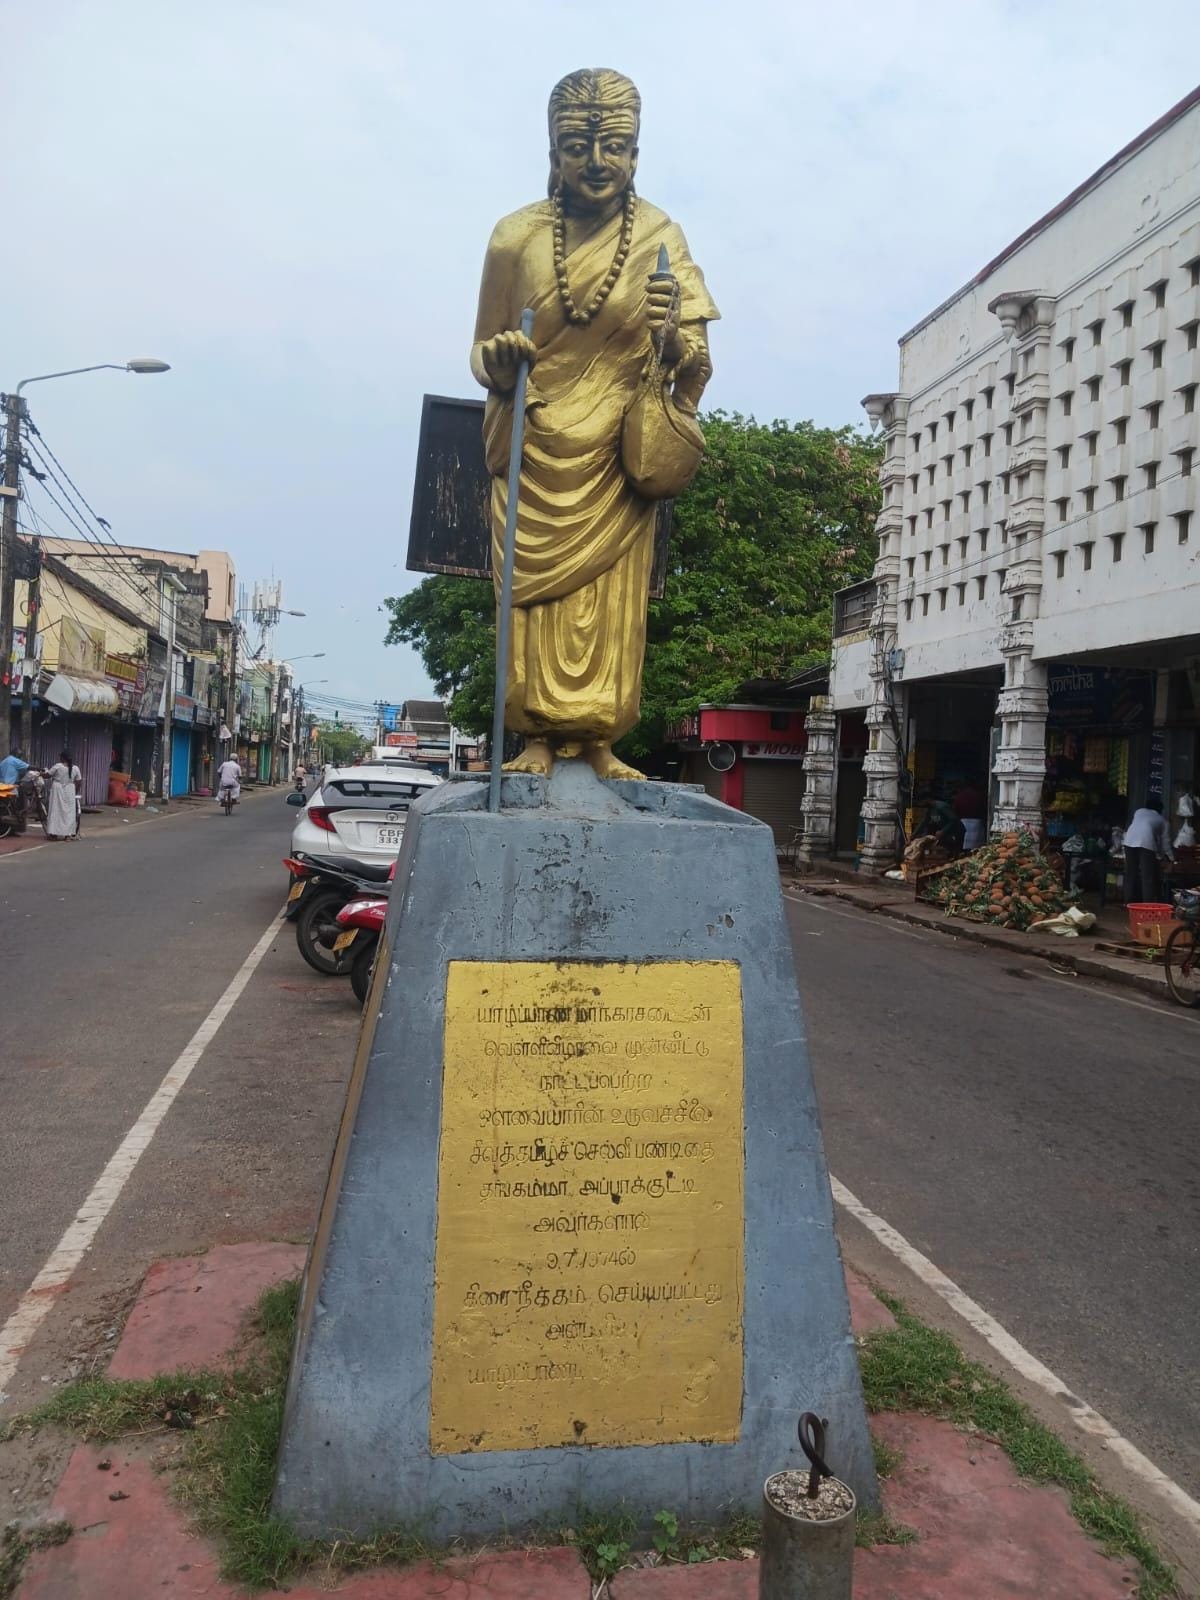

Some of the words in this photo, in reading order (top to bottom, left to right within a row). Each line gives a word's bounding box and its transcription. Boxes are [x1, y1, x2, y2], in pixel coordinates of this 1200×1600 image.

[378, 836, 403, 845] 333
[574, 1136, 632, 1161] செல்வி
[635, 1140, 716, 1164] பண்டிதை
[479, 1178, 569, 1203] தங்கம்மா
[579, 1171, 699, 1199] அப்பாக்குட்டி
[533, 1211, 651, 1234] அவர்களால்
